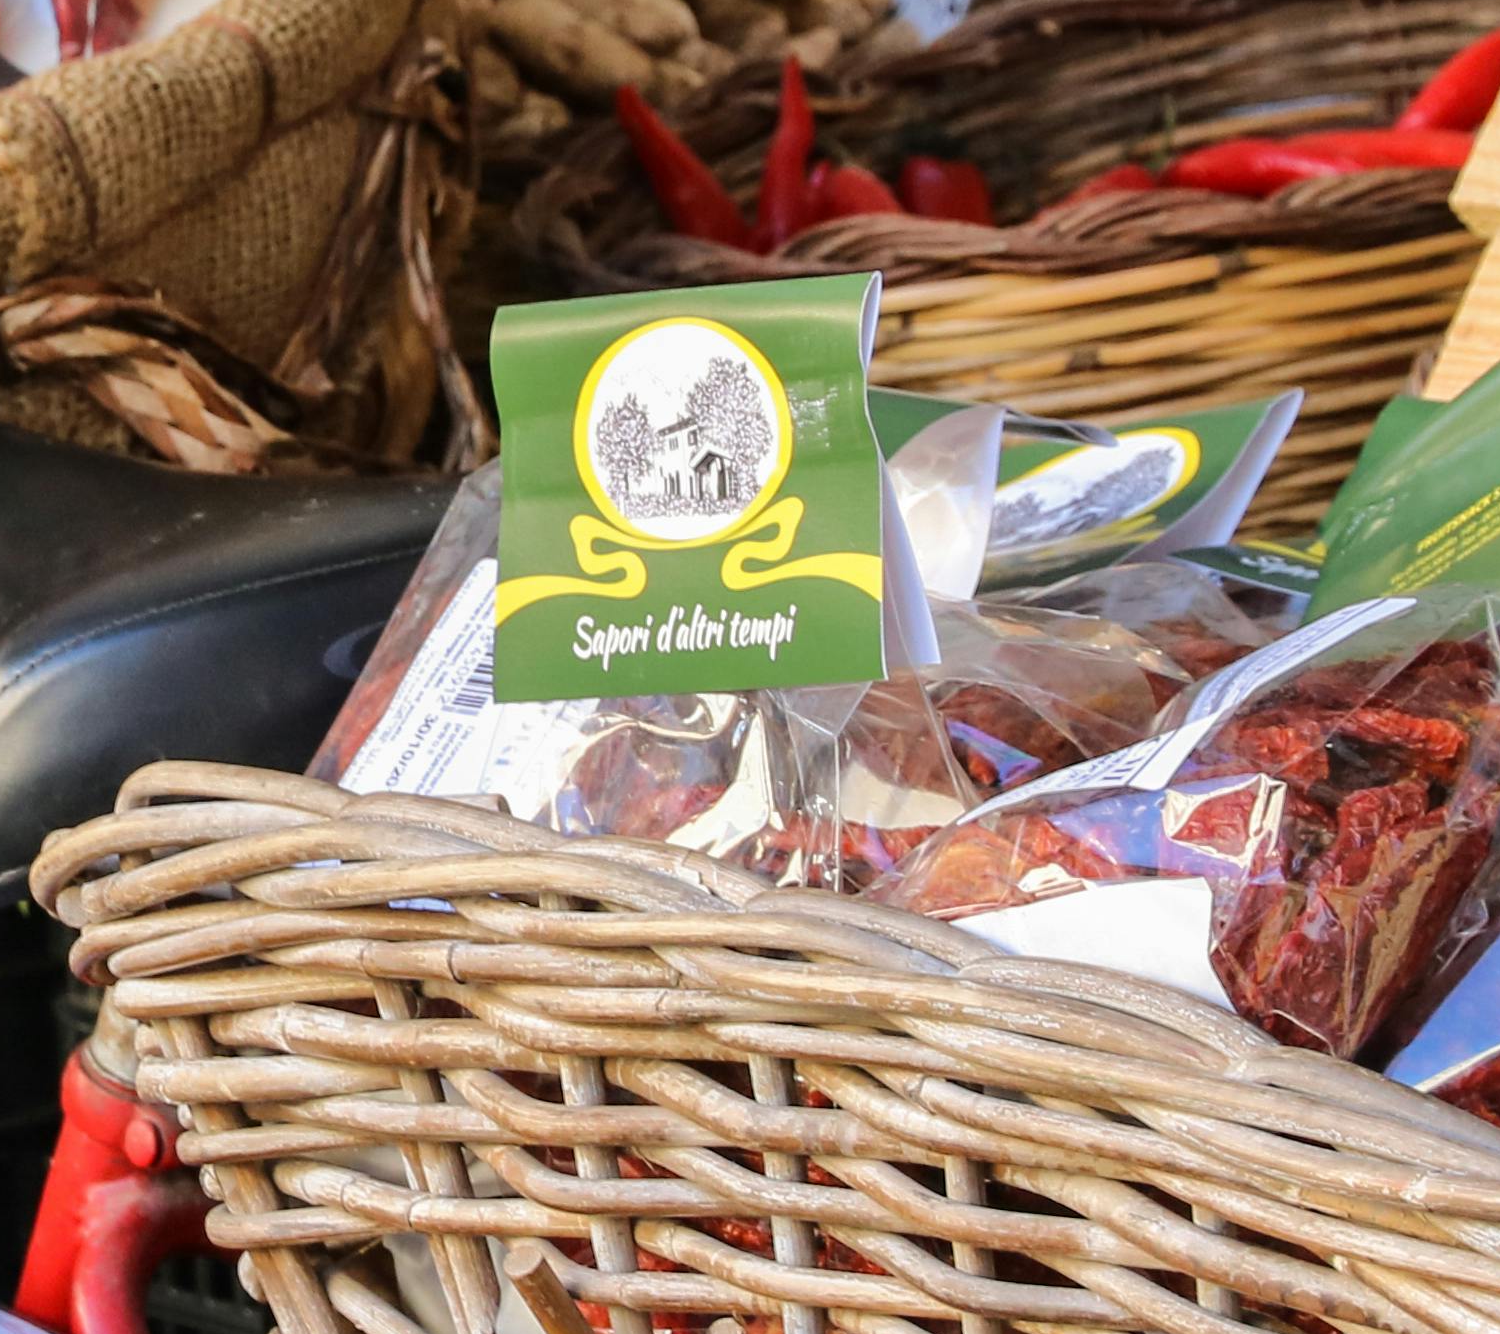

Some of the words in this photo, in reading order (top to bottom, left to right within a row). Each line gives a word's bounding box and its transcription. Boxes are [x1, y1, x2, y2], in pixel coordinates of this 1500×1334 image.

[572, 614, 653, 673] Sapori
[656, 603, 728, 654] d'altri
[729, 603, 798, 663] tempi
